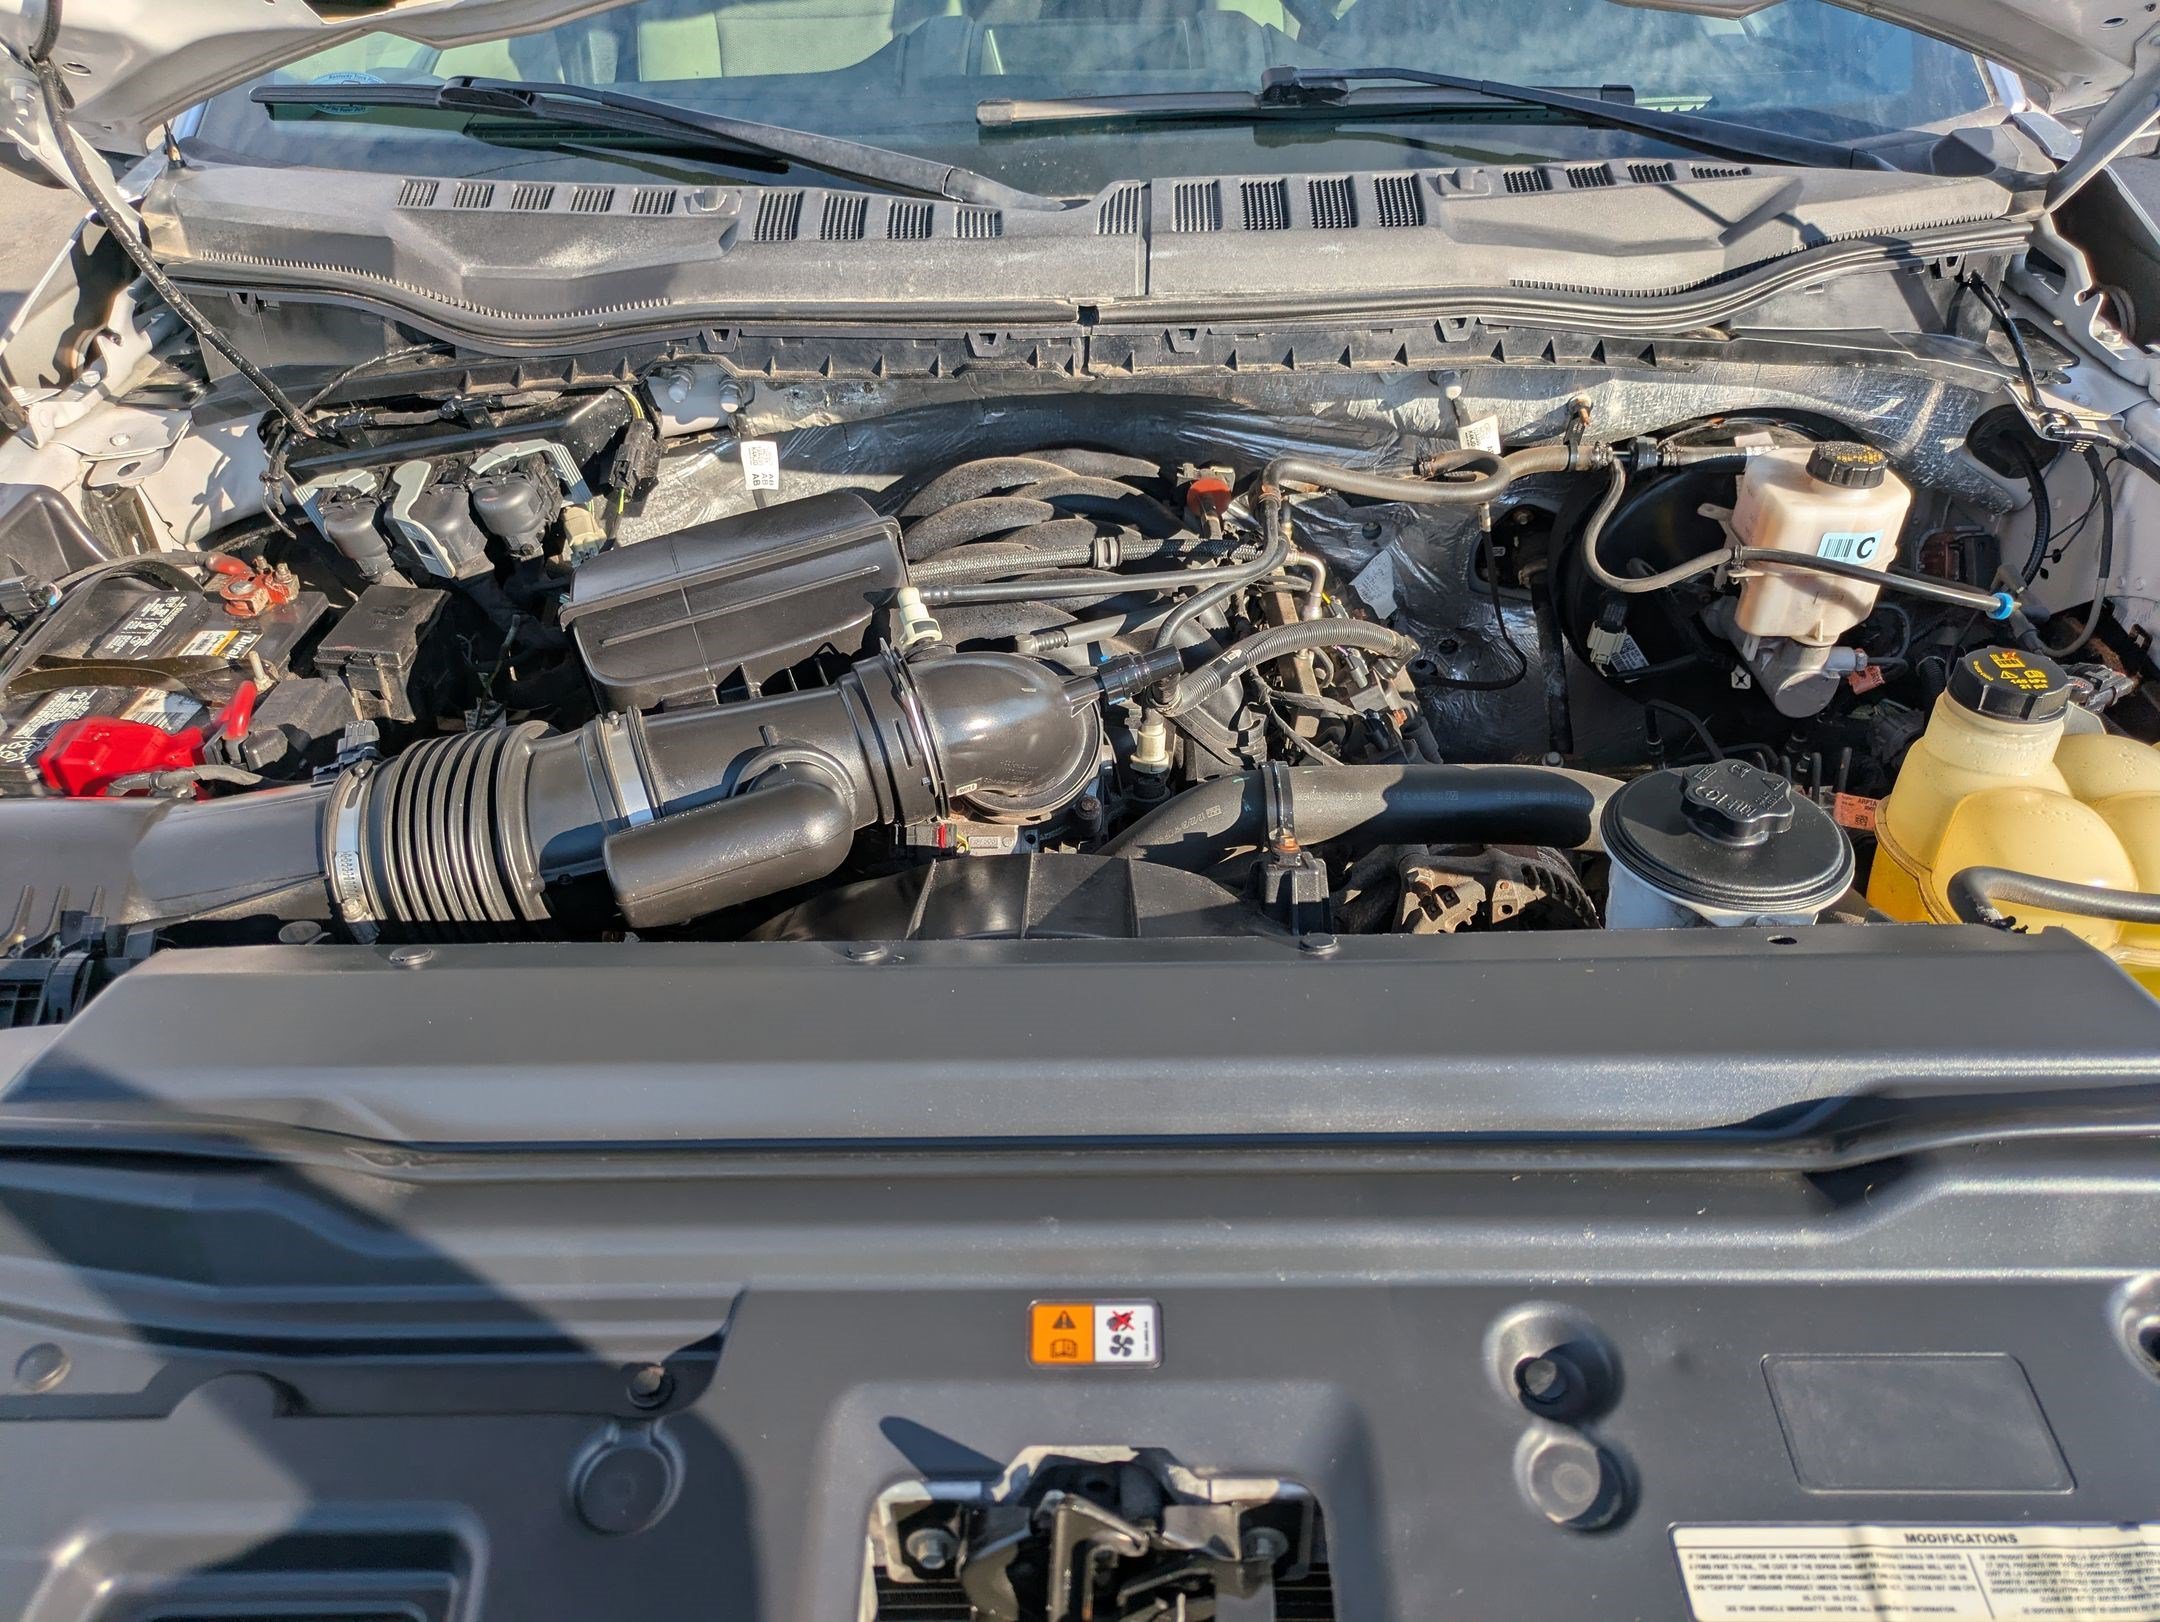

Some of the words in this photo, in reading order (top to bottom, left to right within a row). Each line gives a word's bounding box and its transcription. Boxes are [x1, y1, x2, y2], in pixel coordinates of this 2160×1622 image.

[751, 473, 760, 487] AB
[761, 472, 768, 486] AB
[1856, 535, 1879, 560] C
[1904, 1532, 2019, 1545] MODIFICATIONS
